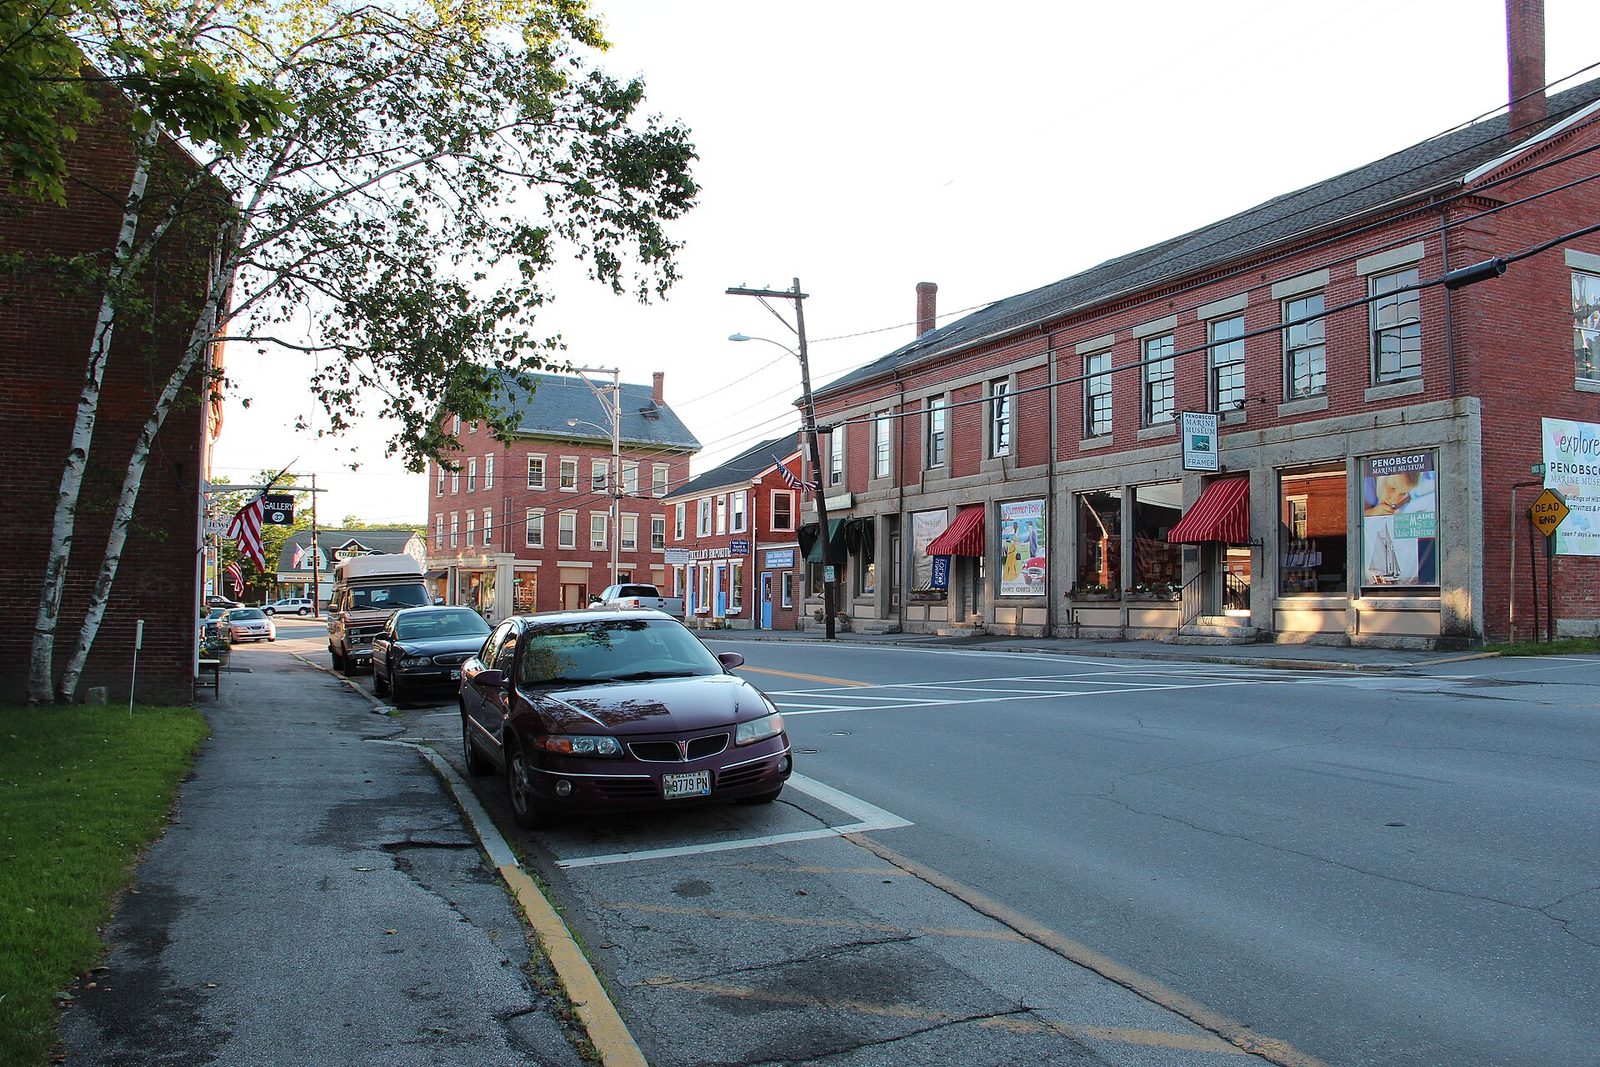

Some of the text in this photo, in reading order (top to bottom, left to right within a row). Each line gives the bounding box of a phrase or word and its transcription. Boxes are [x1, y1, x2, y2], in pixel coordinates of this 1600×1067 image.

[1185, 419, 1214, 428] MARINE
[1560, 430, 1600, 457] explore
[1372, 454, 1425, 468] PENOBSCOT
[1372, 463, 1425, 474] MARINE MUSEUM
[1550, 462, 1600, 476] PENOBSC
[1550, 476, 1579, 486] MARINE
[264, 501, 294, 511] GALLERY
[1536, 502, 1560, 512] DEAD
[1538, 515, 1556, 524] END
[673, 777, 708, 792] 9779 PN
